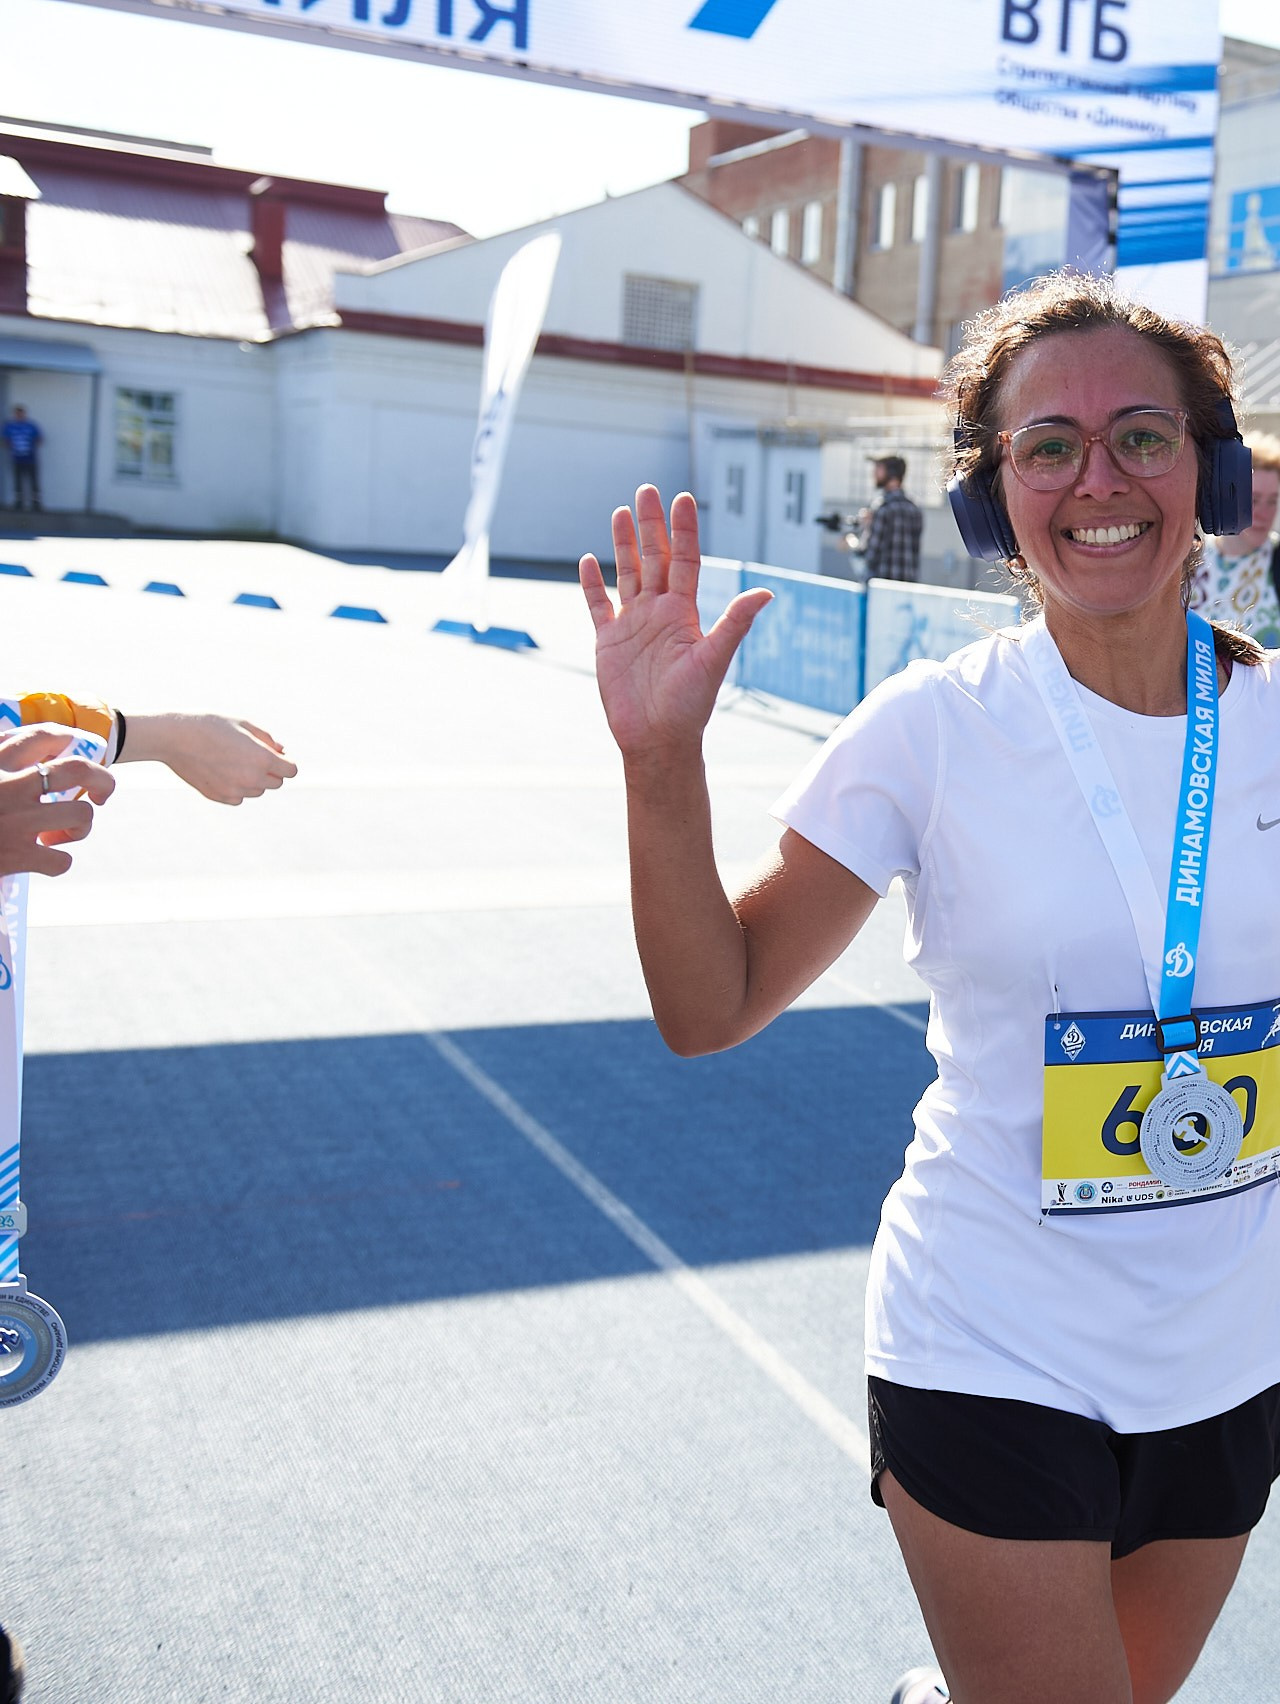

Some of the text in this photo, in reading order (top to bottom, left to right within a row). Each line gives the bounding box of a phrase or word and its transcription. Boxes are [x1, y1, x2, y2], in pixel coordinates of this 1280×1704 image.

[1002, 0, 1128, 62] ВТБ
[1176, 639, 1215, 907] ДИНАМОВСКАЯ МИЛЯ
[1120, 1016, 1253, 1040] ДИНВСКАЯ
[1101, 1075, 1258, 1156] 60
[1101, 1195, 1124, 1204] Nika
[1134, 1193, 1154, 1201] UDS
